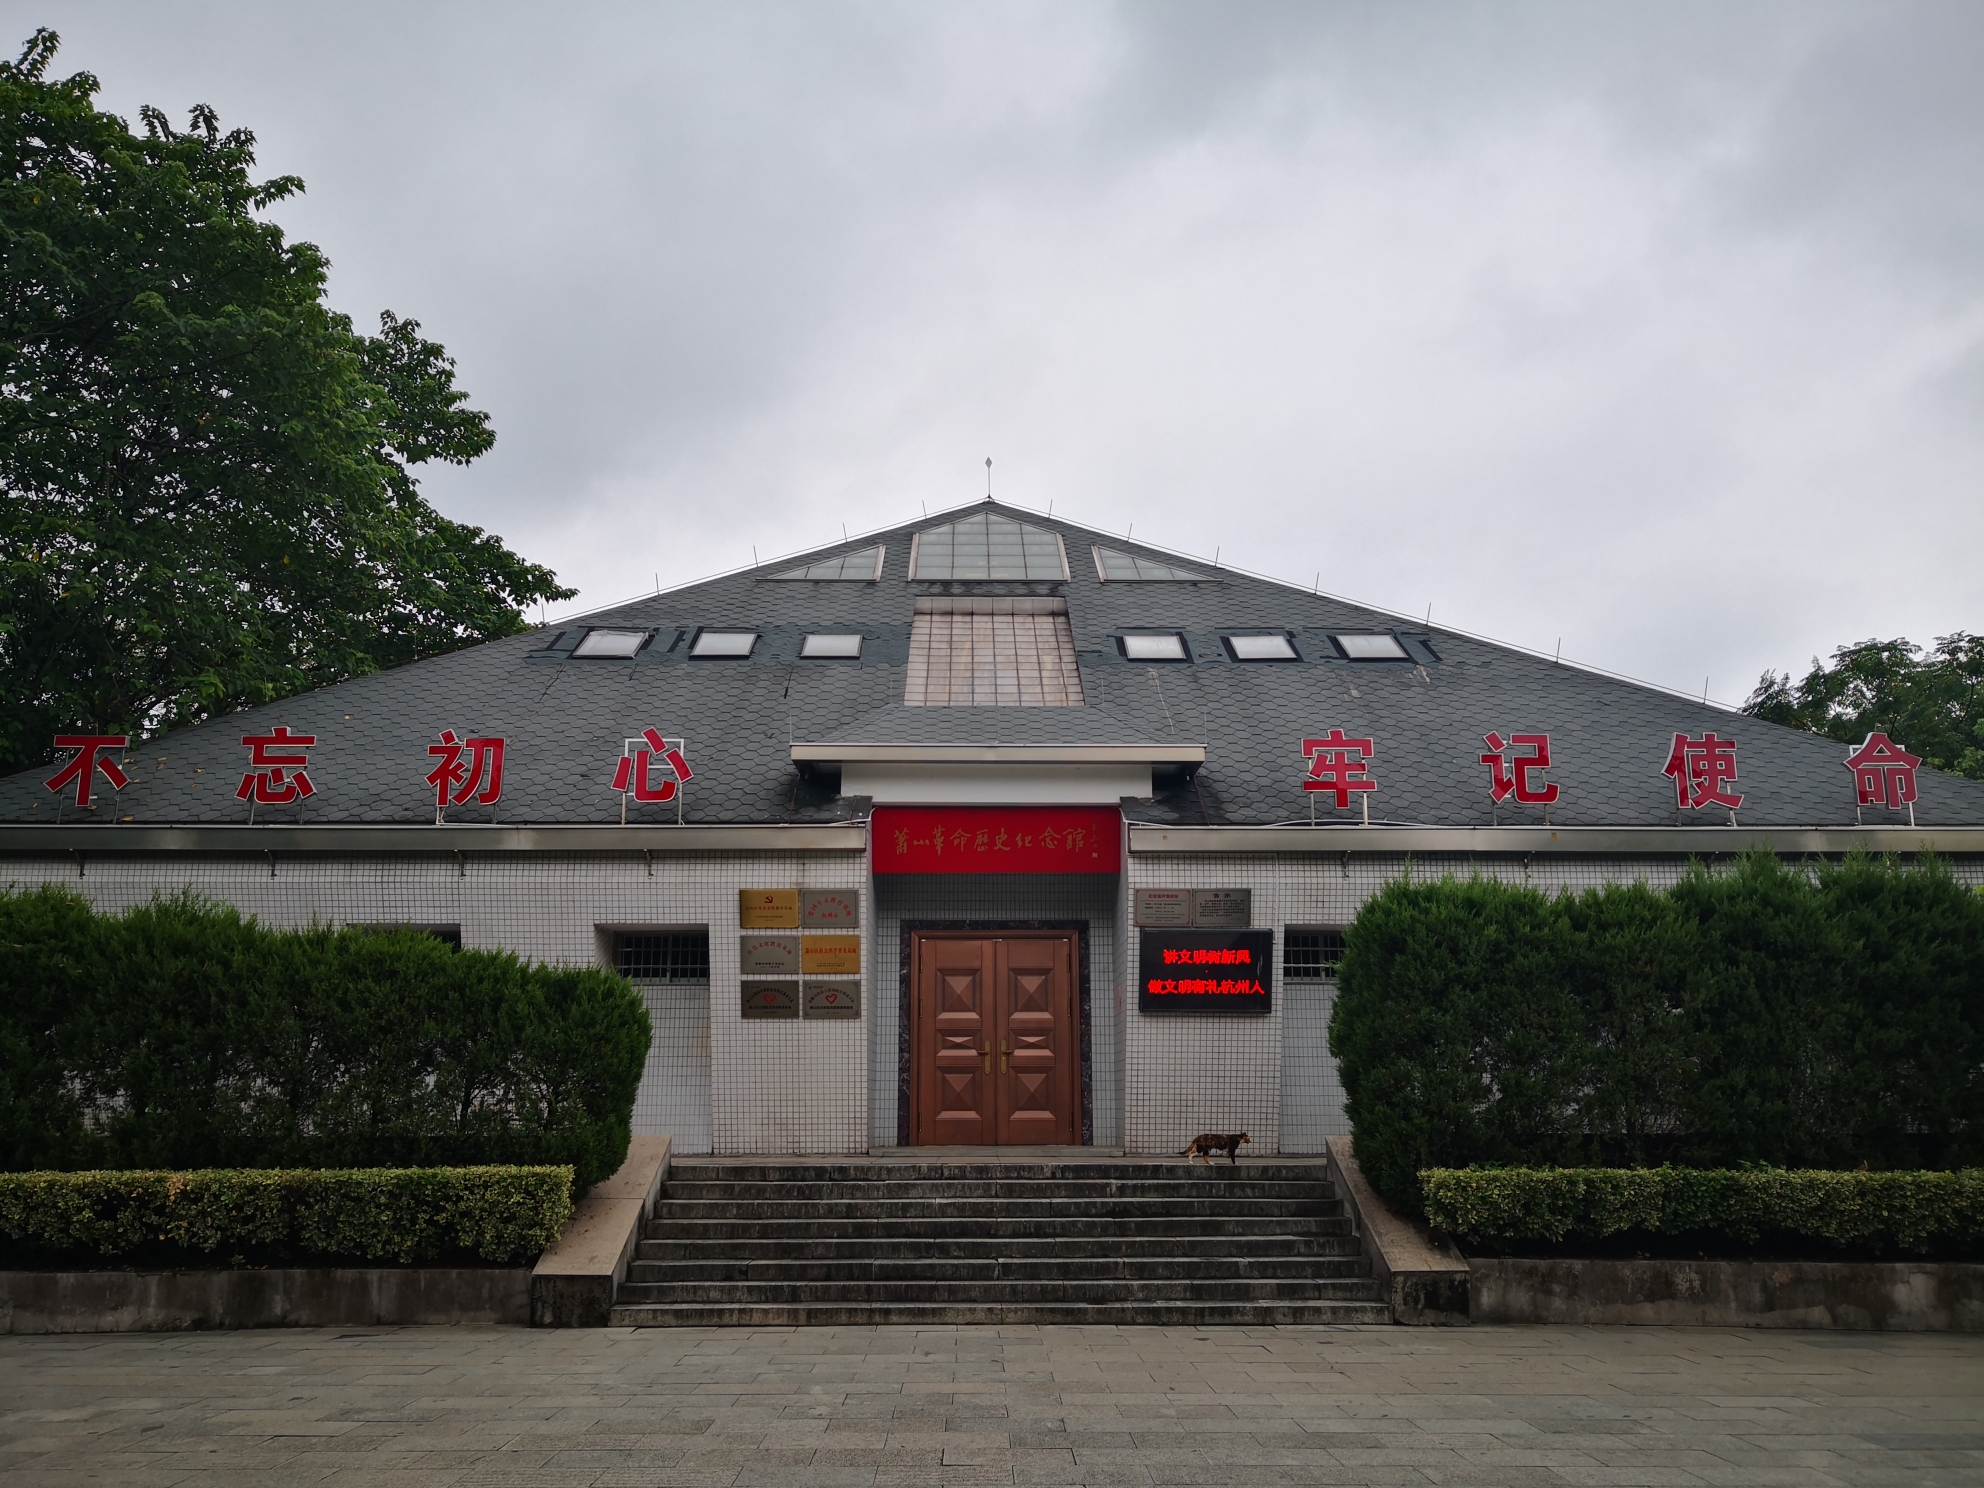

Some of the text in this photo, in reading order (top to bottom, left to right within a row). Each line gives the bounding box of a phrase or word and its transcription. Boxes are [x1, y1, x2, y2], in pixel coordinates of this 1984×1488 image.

[42, 726, 696, 808] 不忘初心
[1300, 728, 1924, 810] 牢记使命
[1163, 949, 1251, 964] 讲文明树新风
[1148, 979, 1265, 994] 做文明有礼杭州人
